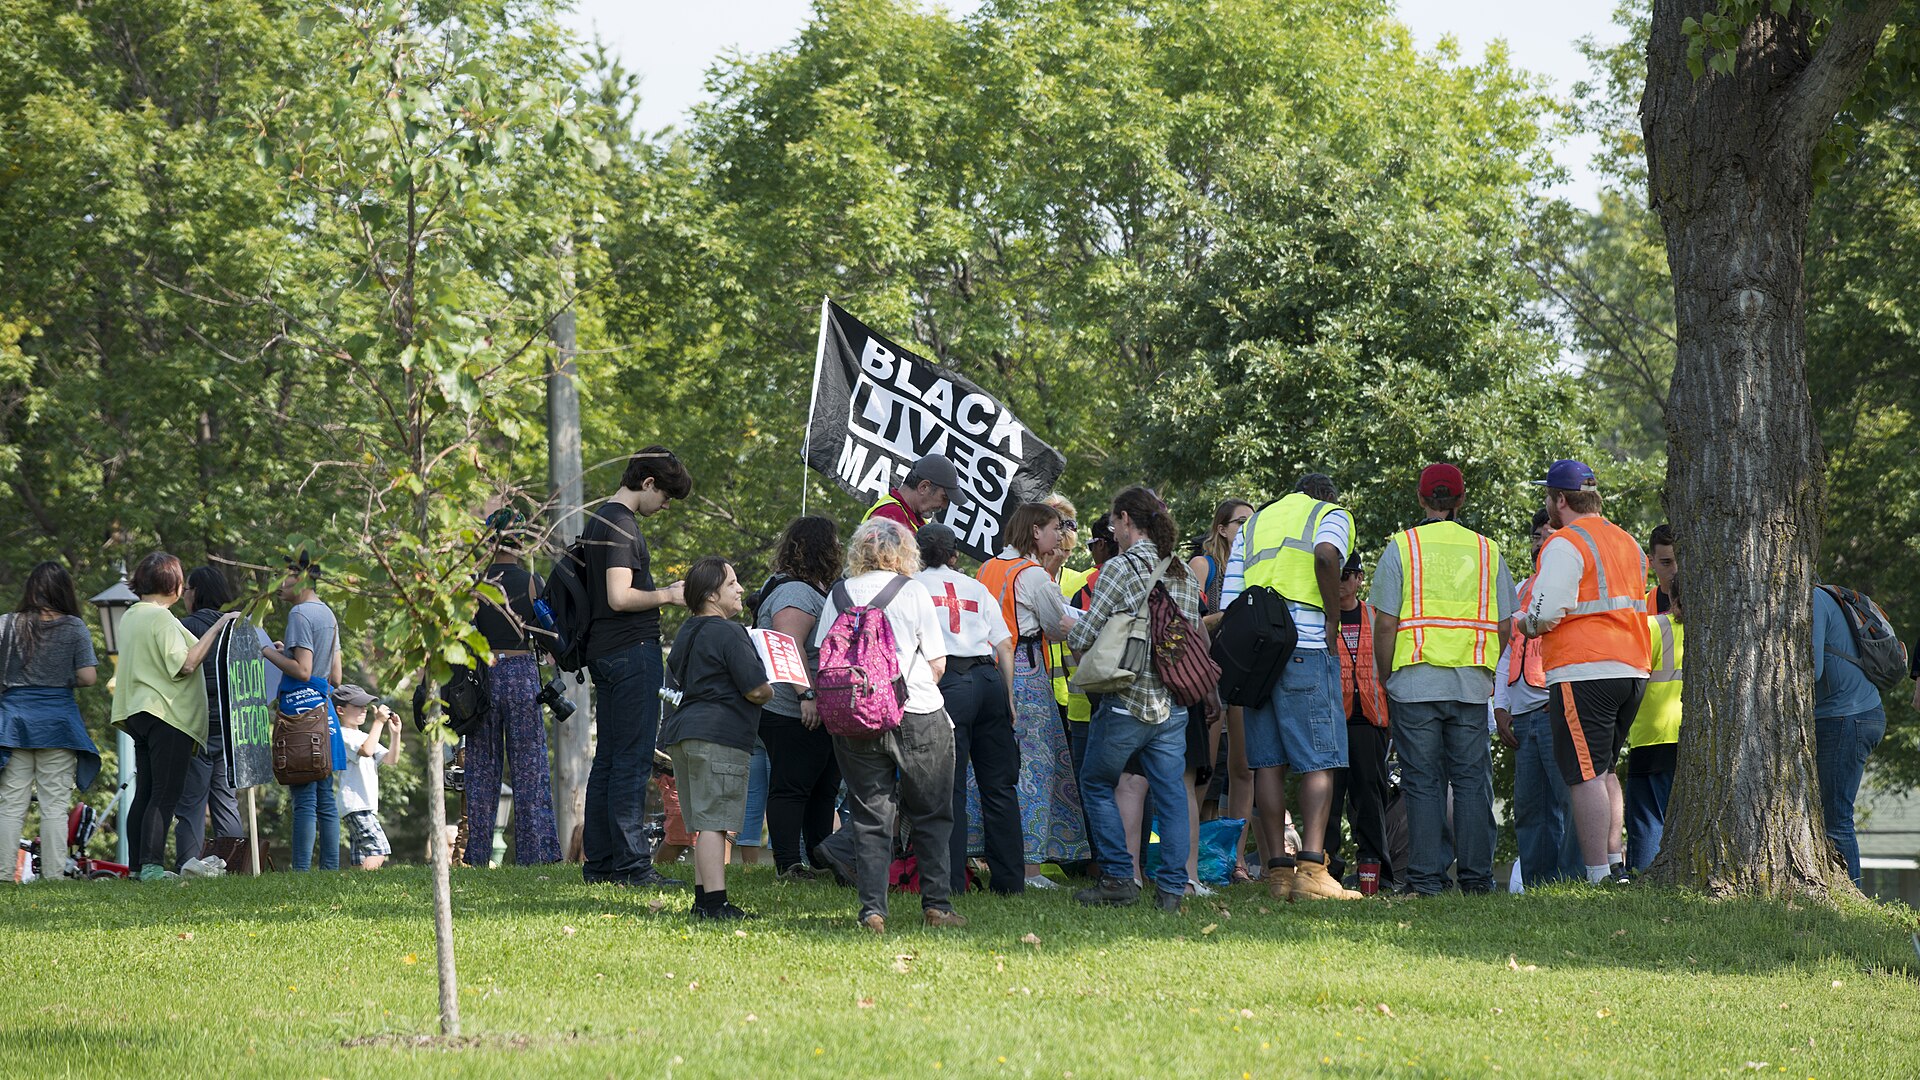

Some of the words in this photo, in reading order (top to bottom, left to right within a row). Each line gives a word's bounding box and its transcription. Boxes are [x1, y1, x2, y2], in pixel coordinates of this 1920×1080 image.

[852, 381, 1008, 502] LIVES
[861, 336, 1026, 460] BLACK
[837, 434, 1000, 556] MAER
[766, 631, 793, 680] AGAINST
